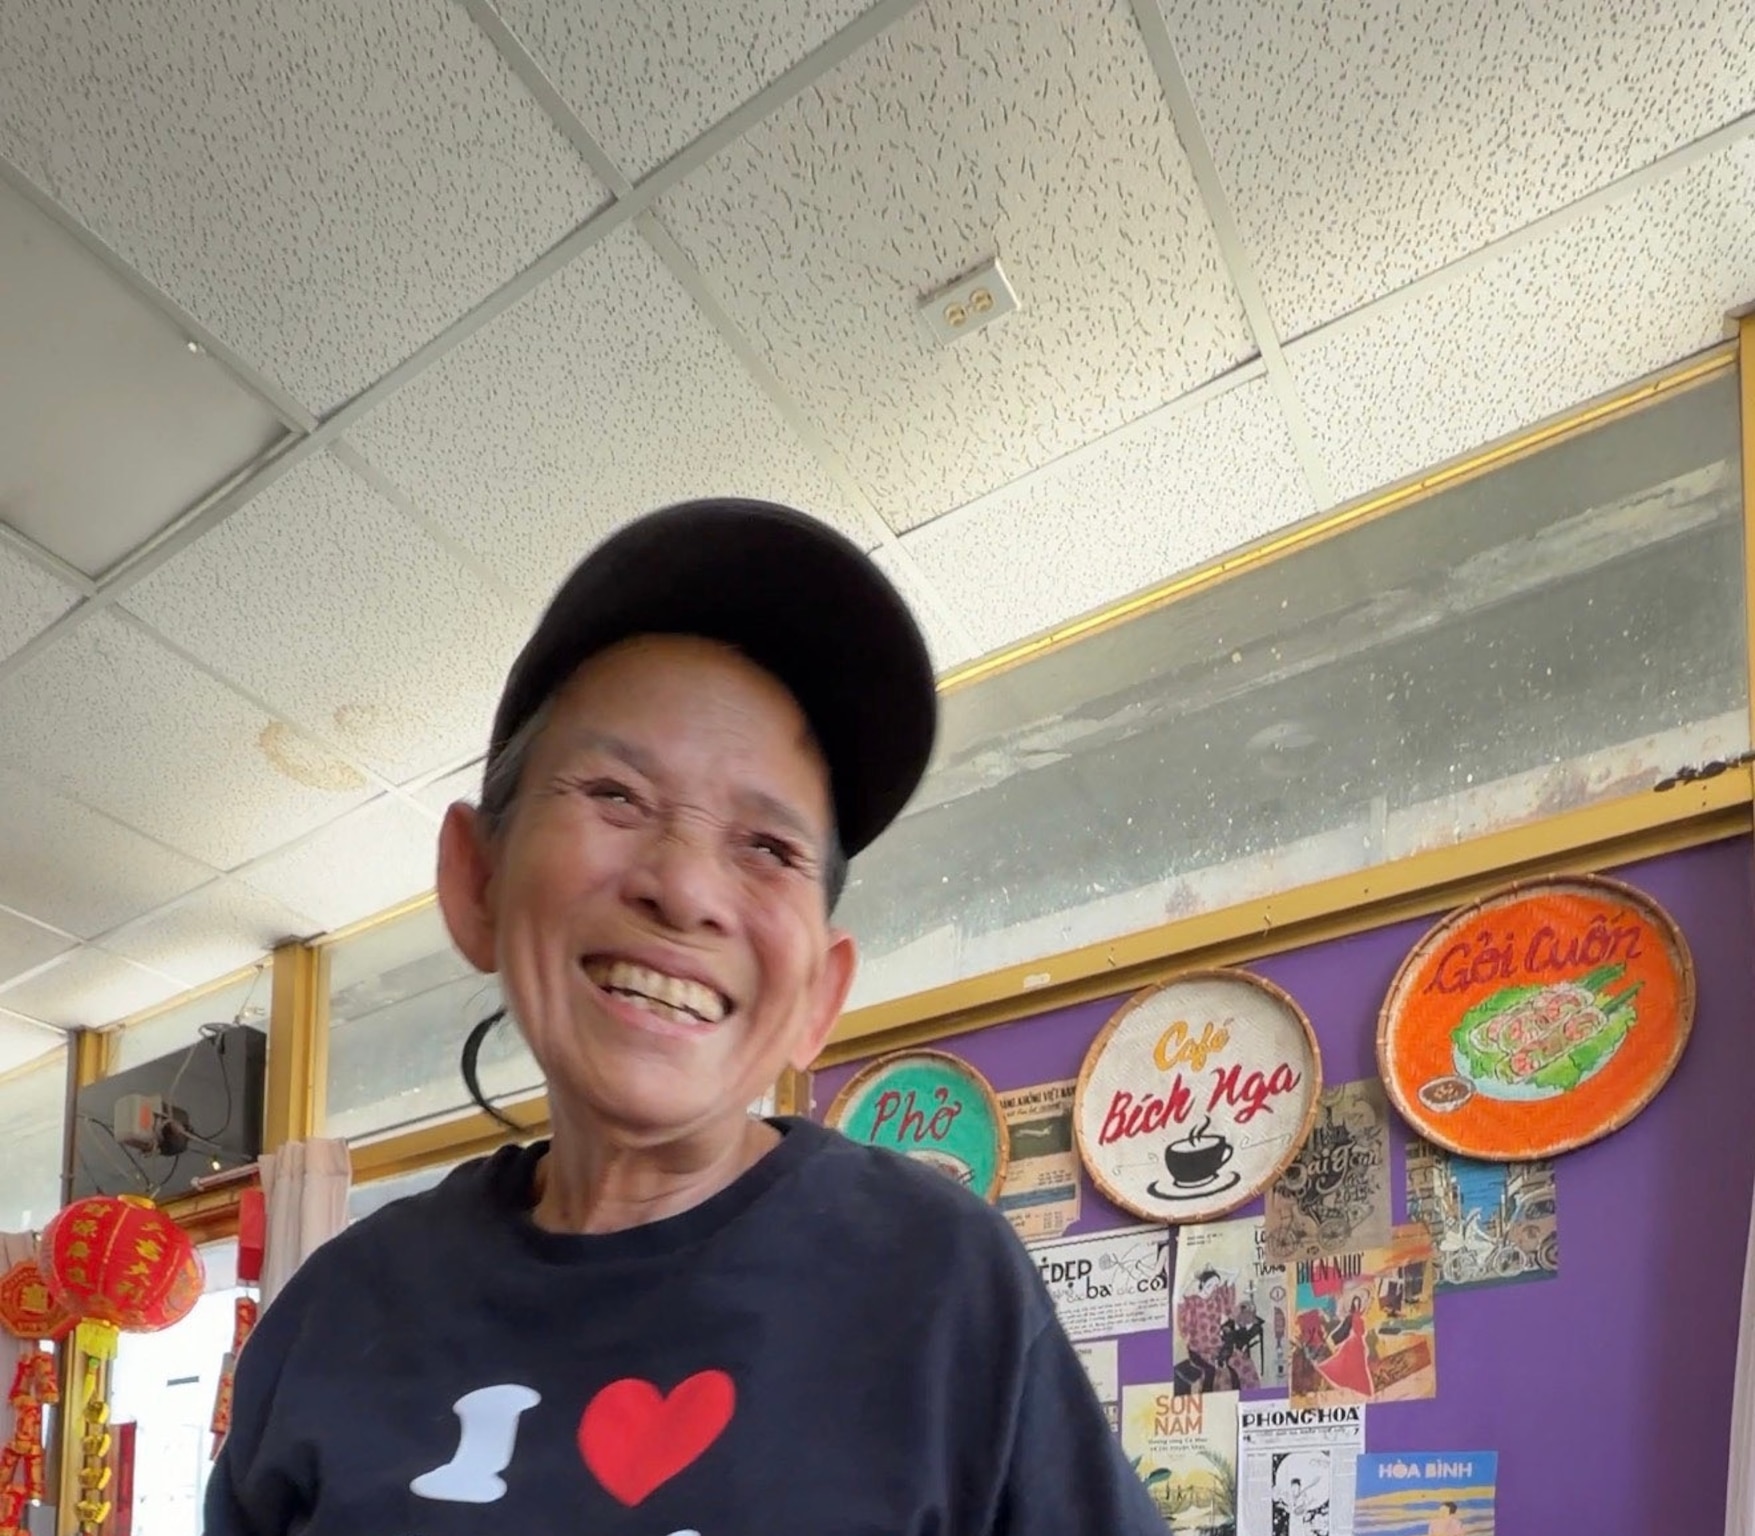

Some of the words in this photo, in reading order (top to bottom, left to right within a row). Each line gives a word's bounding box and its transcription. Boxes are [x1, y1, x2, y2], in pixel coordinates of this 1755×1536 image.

[1423, 930, 1518, 994] Gỏi
[1154, 1018, 1234, 1072] Café
[870, 1087, 962, 1142] Phở
[1099, 1073, 1195, 1146] Bích
[1208, 1063, 1302, 1124] Nga
[410, 1384, 541, 1502] I
[1155, 1416, 1203, 1437] NAM
[1379, 1459, 1420, 1478] HÒA
